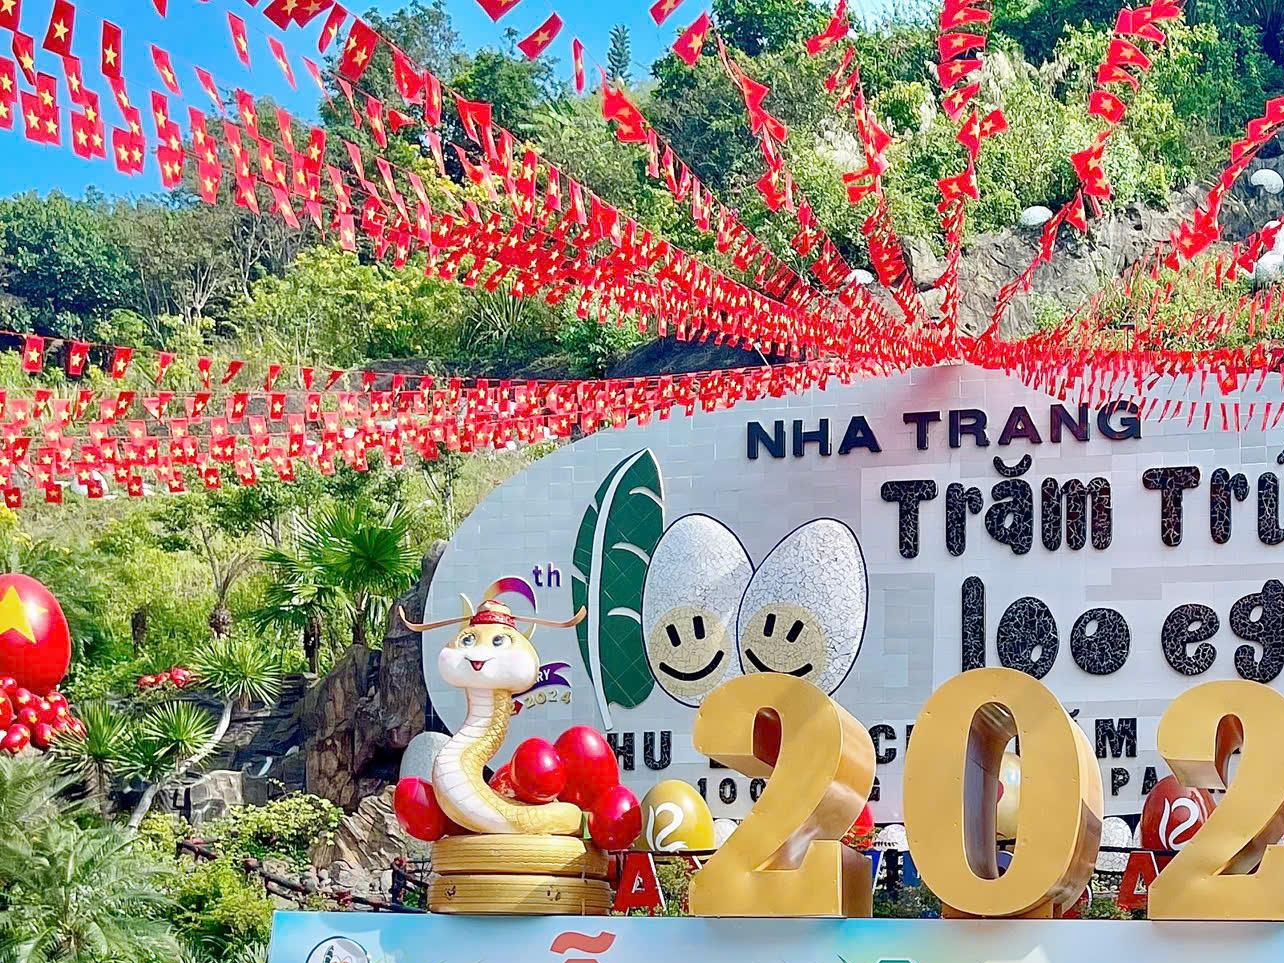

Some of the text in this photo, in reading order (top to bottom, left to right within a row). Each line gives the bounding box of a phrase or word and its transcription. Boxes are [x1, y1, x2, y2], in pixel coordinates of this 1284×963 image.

[746, 399, 1143, 460] NHA TRANG
[881, 454, 1112, 560] Trăm
[532, 562, 562, 588] th
[524, 689, 572, 710] 2024
[605, 730, 673, 771] HU
